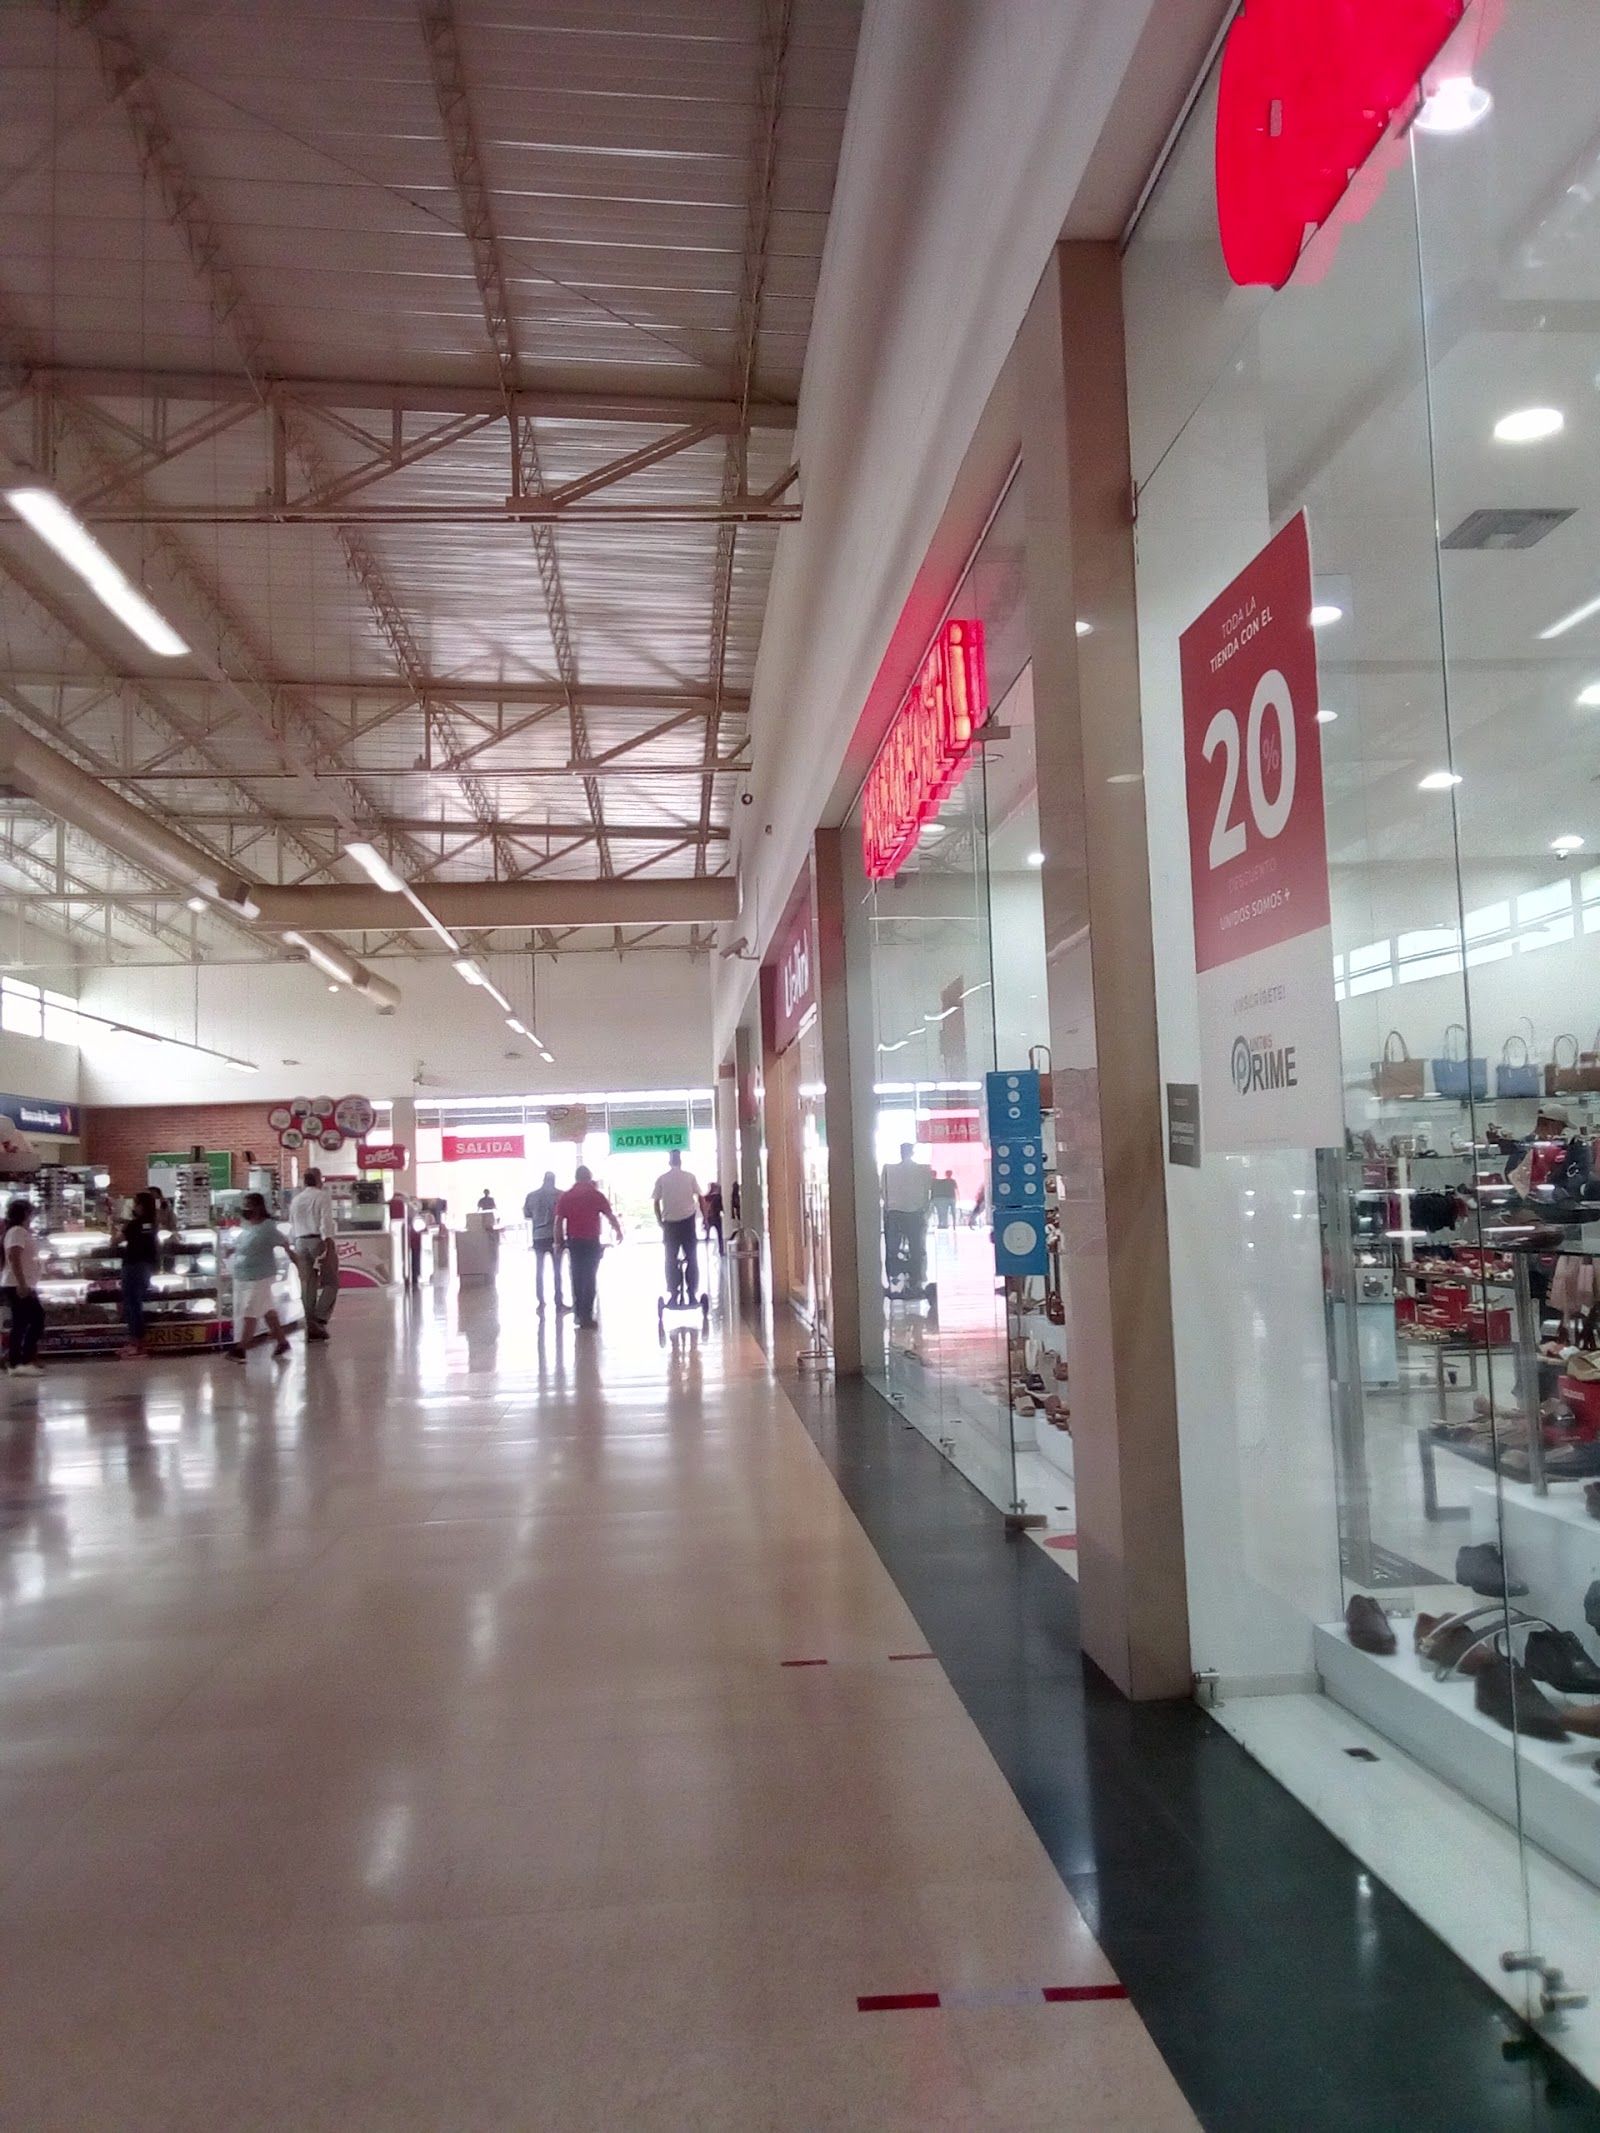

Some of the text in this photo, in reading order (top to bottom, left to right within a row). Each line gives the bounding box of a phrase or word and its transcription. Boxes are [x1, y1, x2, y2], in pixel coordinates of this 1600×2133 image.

[1222, 595, 1257, 639] TODA LA
[1210, 606, 1273, 673] TIENDA CON EL
[1201, 668, 1297, 871] 20
[1251, 889, 1283, 917] SOMOS
[455, 1141, 513, 1155] SALIDA
